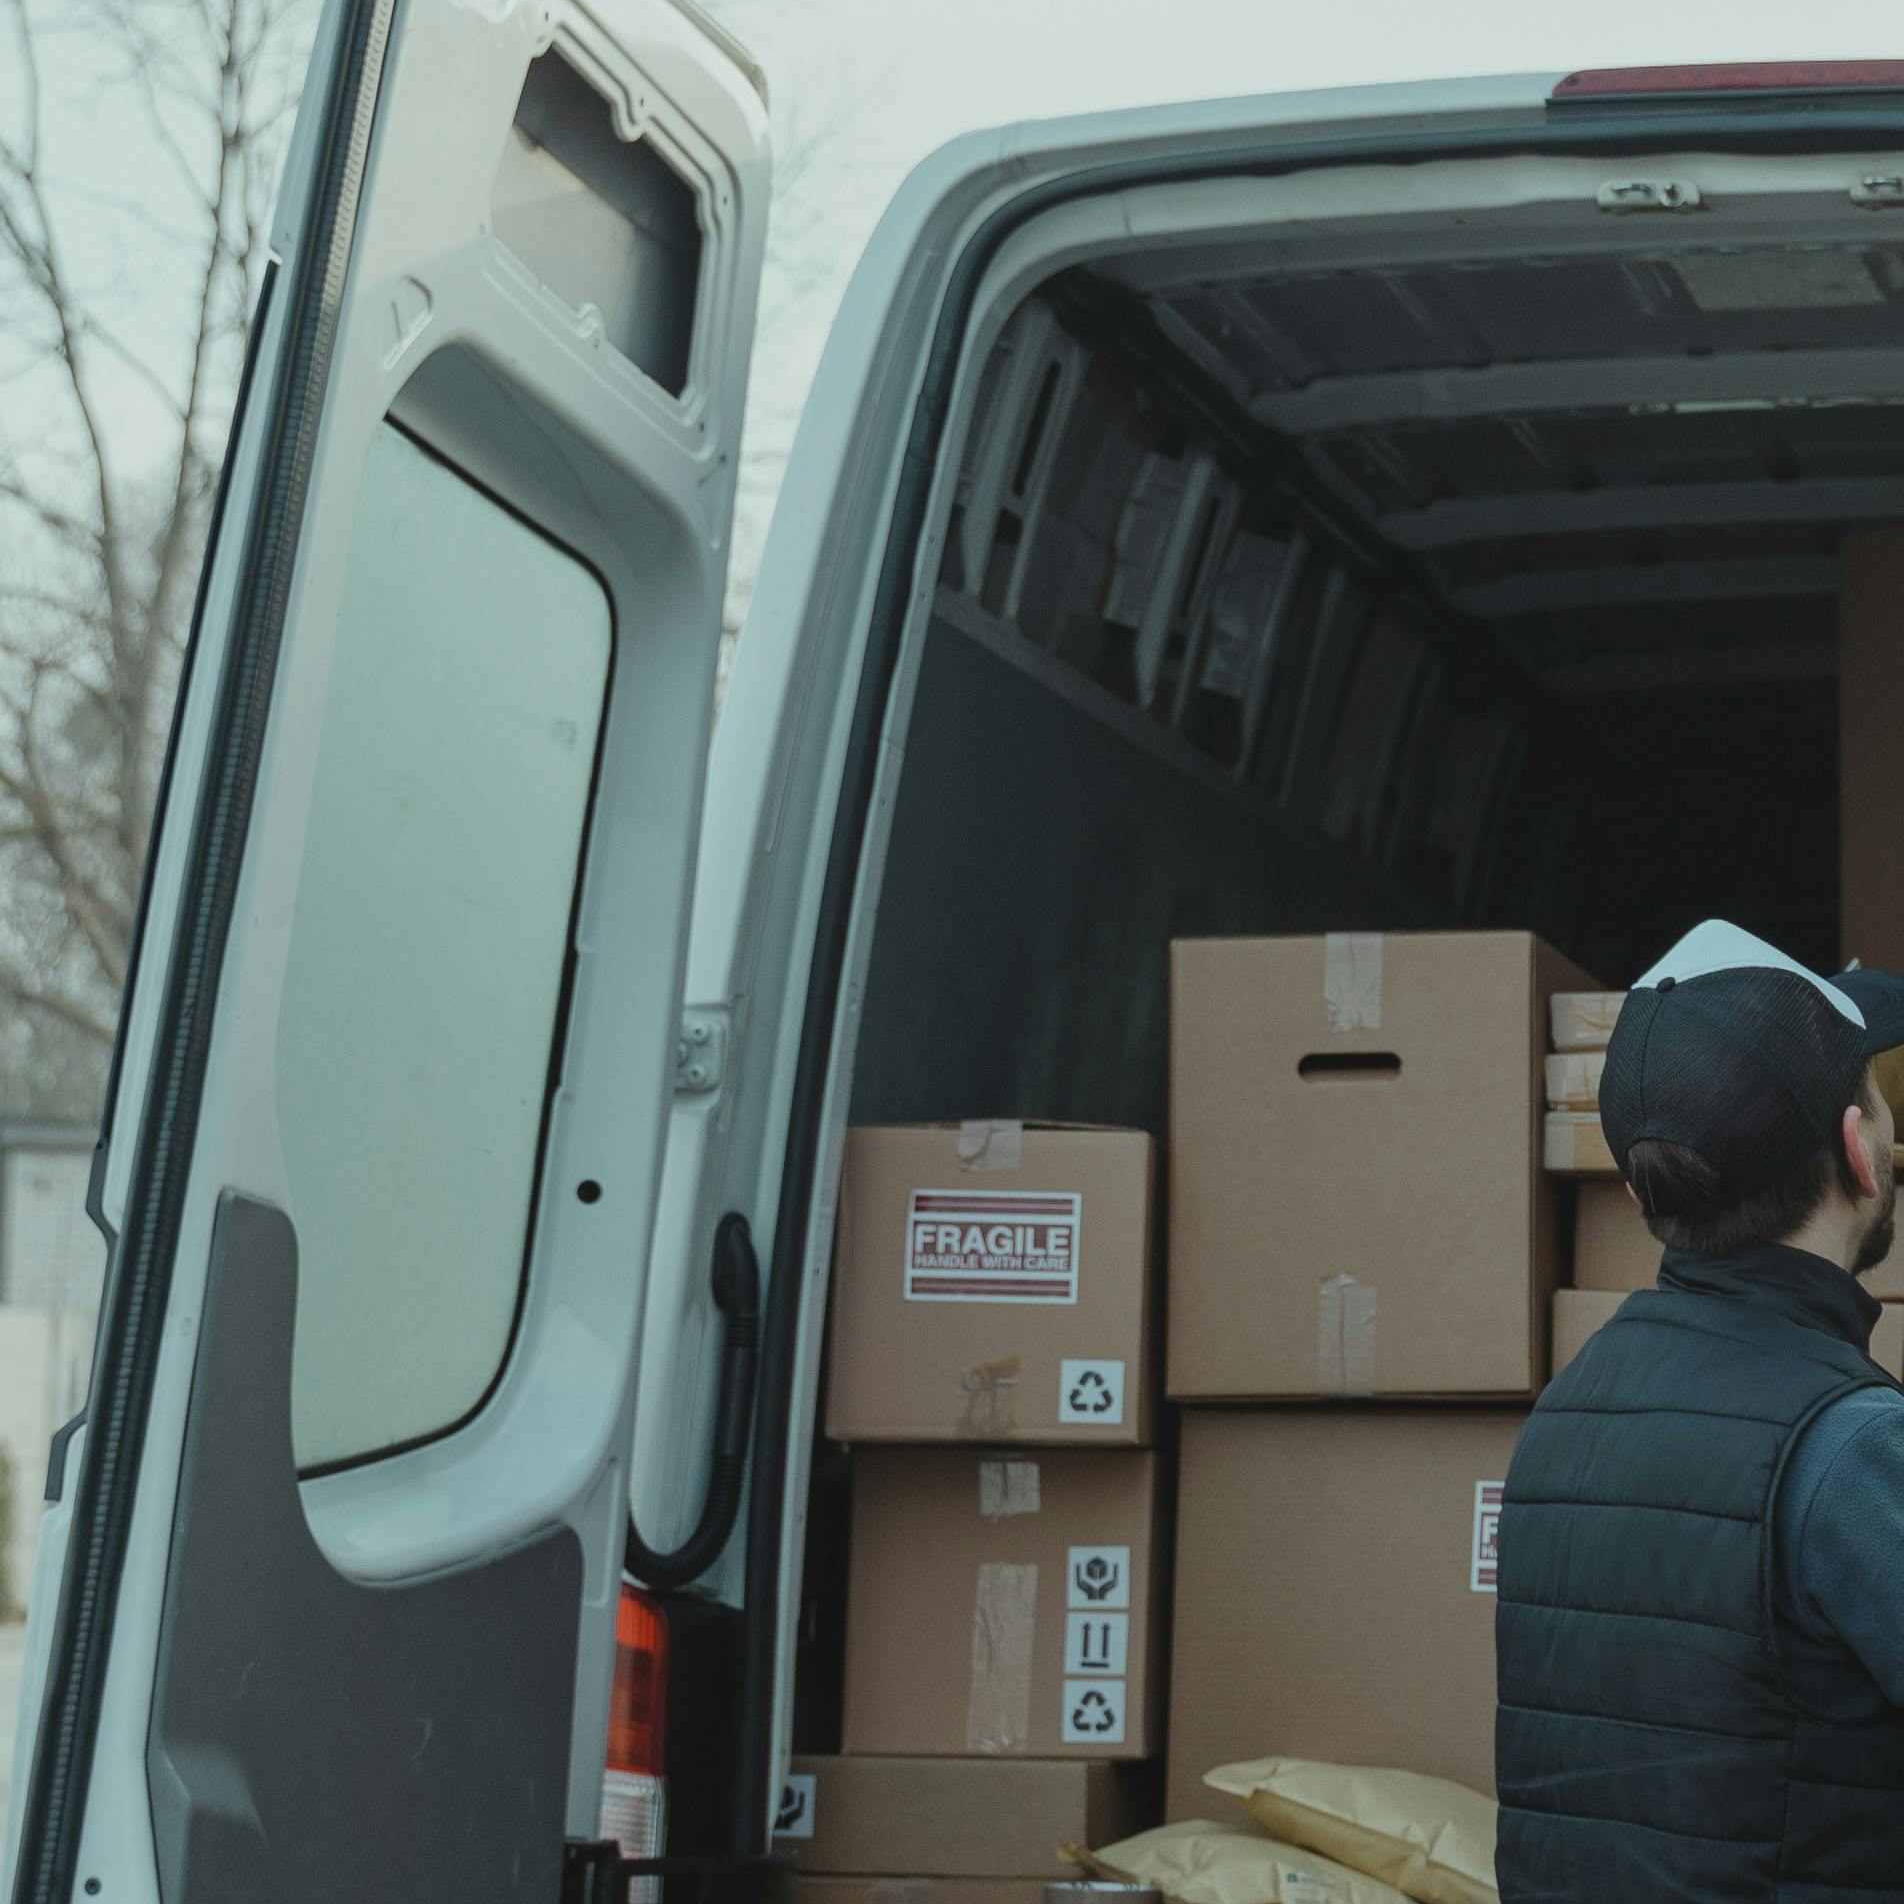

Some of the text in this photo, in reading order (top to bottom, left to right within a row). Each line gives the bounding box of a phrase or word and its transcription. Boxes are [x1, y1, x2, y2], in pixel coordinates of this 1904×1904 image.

[915, 1224, 1070, 1256] FRAGILE
[914, 1255, 1070, 1271] HANDLE WITH CARE
